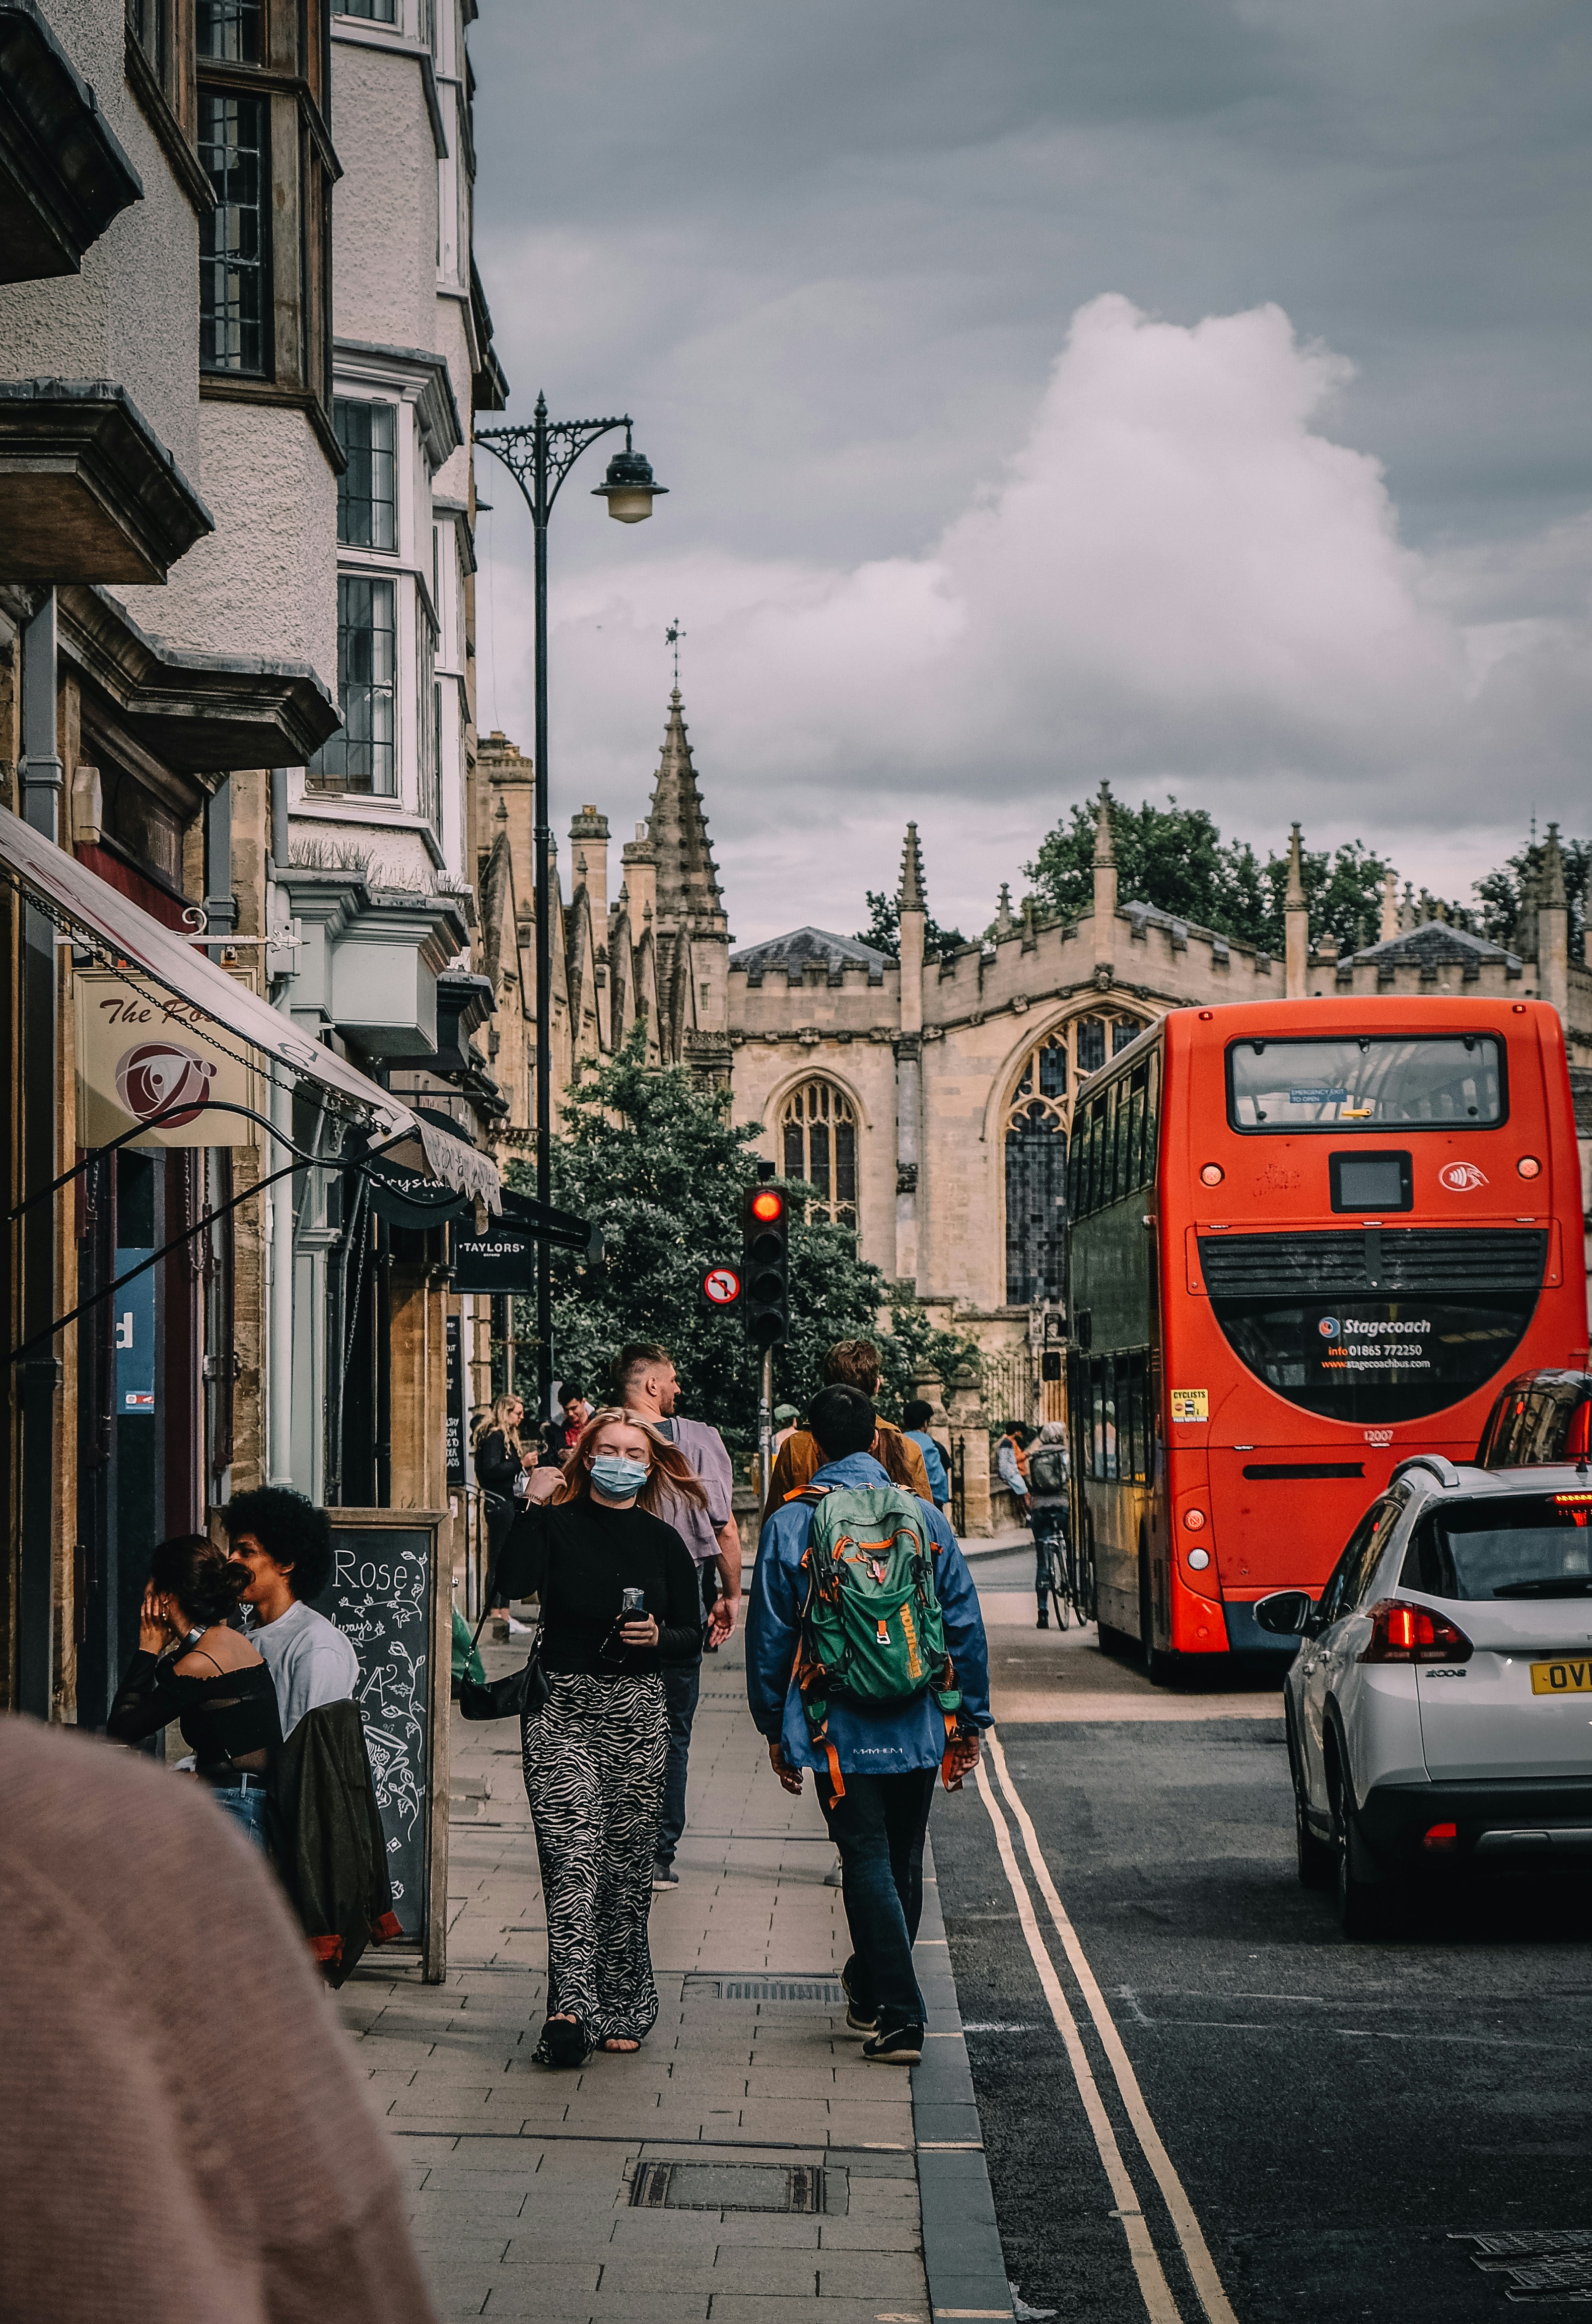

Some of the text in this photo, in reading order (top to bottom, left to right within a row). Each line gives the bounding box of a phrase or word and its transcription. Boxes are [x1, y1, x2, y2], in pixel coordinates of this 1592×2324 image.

[99, 999, 152, 1024] The
[369, 1173, 450, 1192] Crysta
[464, 1243, 519, 1252] TAYLORS
[1344, 1319, 1431, 1337] Stagecoach
[1328, 1345, 1422, 1356] info 01865 772250
[1364, 1430, 1394, 1441] 12007
[332, 1550, 407, 1590] Rose
[331, 1613, 372, 1640] lways
[1550, 1663, 1592, 1688] OV
